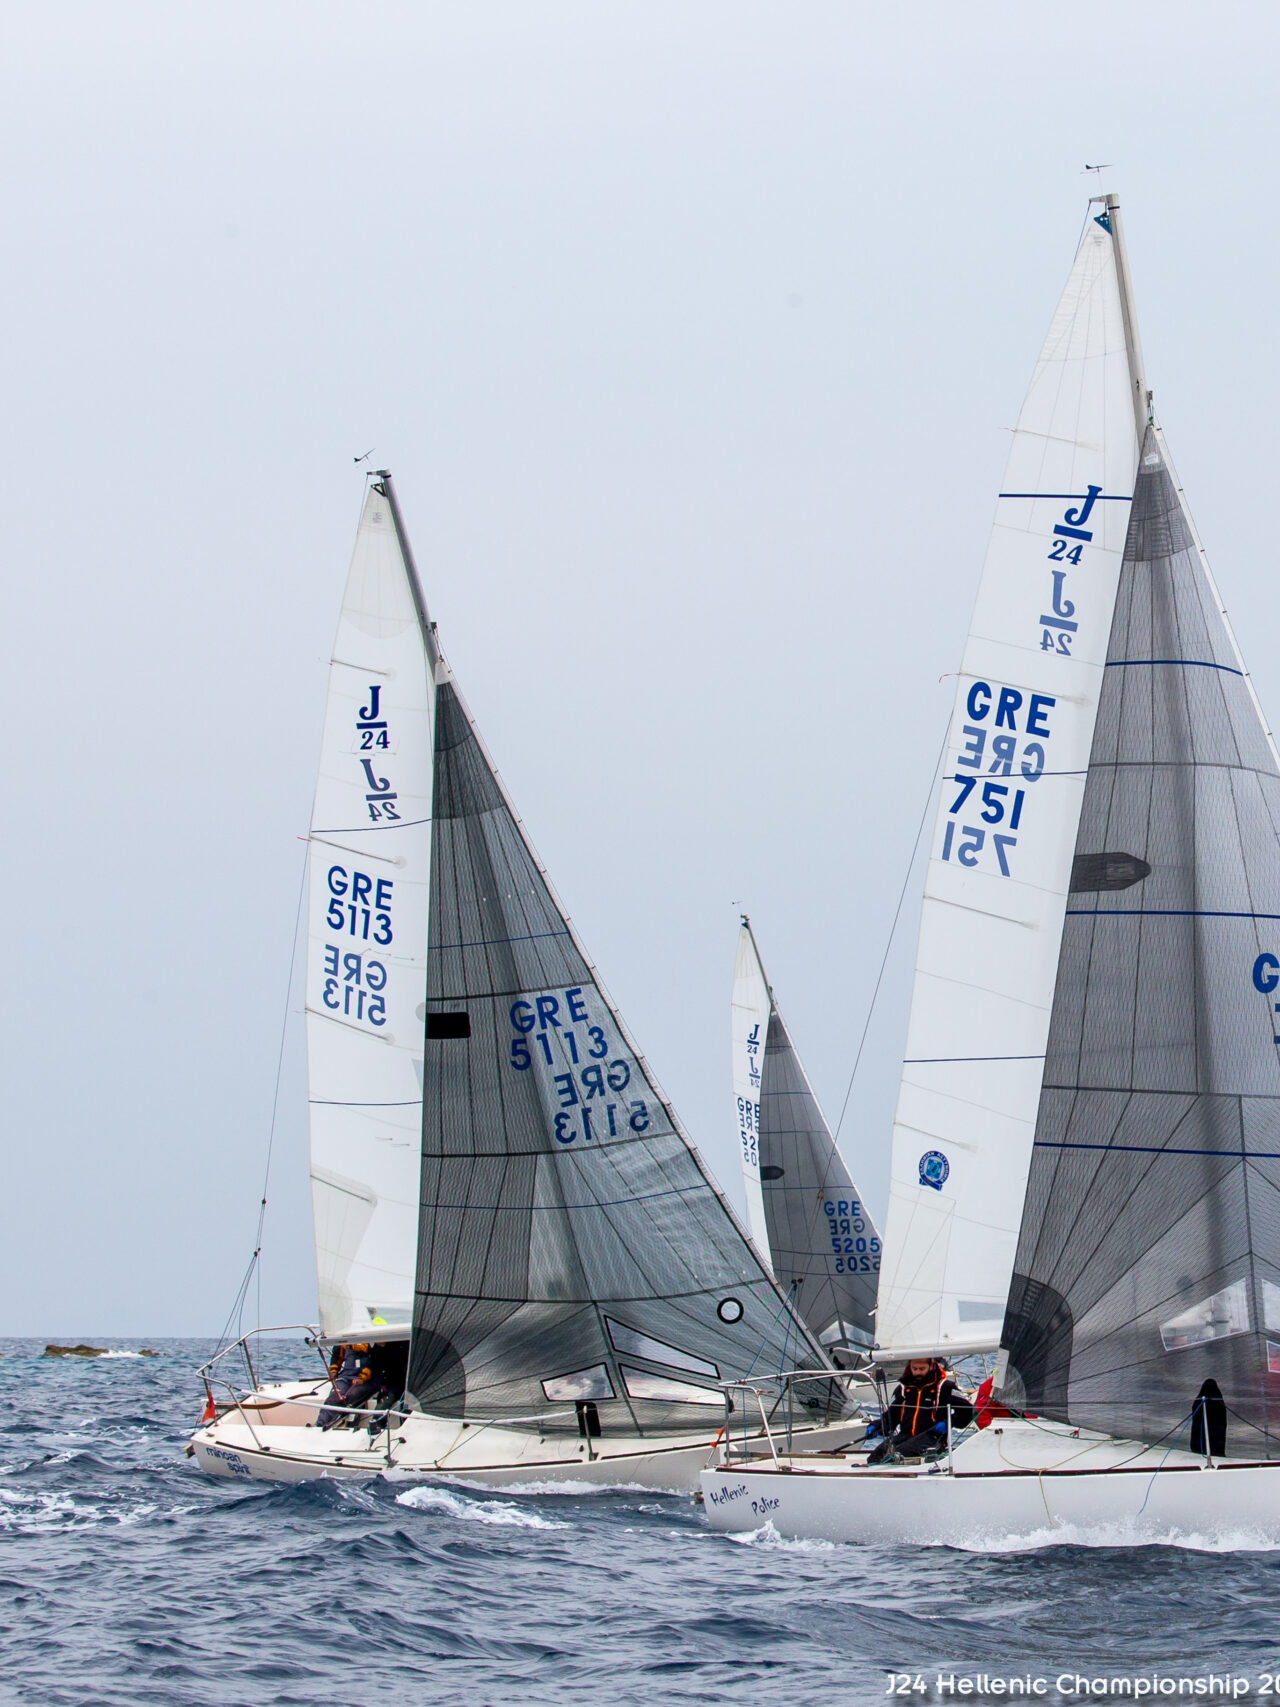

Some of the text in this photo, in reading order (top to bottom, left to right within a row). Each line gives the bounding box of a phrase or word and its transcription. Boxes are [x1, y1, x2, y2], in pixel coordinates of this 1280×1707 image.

[1064, 484, 1103, 527] J
[1048, 539, 1084, 565] 24
[358, 685, 382, 720] J
[967, 681, 1056, 738] GRE
[360, 730, 391, 750] 24
[948, 774, 1025, 830] 751
[327, 865, 394, 912] GRE
[326, 900, 393, 946] 5113
[510, 987, 589, 1034] GRE
[749, 1024, 760, 1040] J
[510, 1026, 608, 1071] 5113
[747, 1044, 757, 1055] 24
[737, 1096, 760, 1119] GRE
[824, 1200, 860, 1216] GRE
[831, 1237, 880, 1253] 5205
[710, 1483, 749, 1507] Hellenic
[751, 1496, 781, 1516] Police
